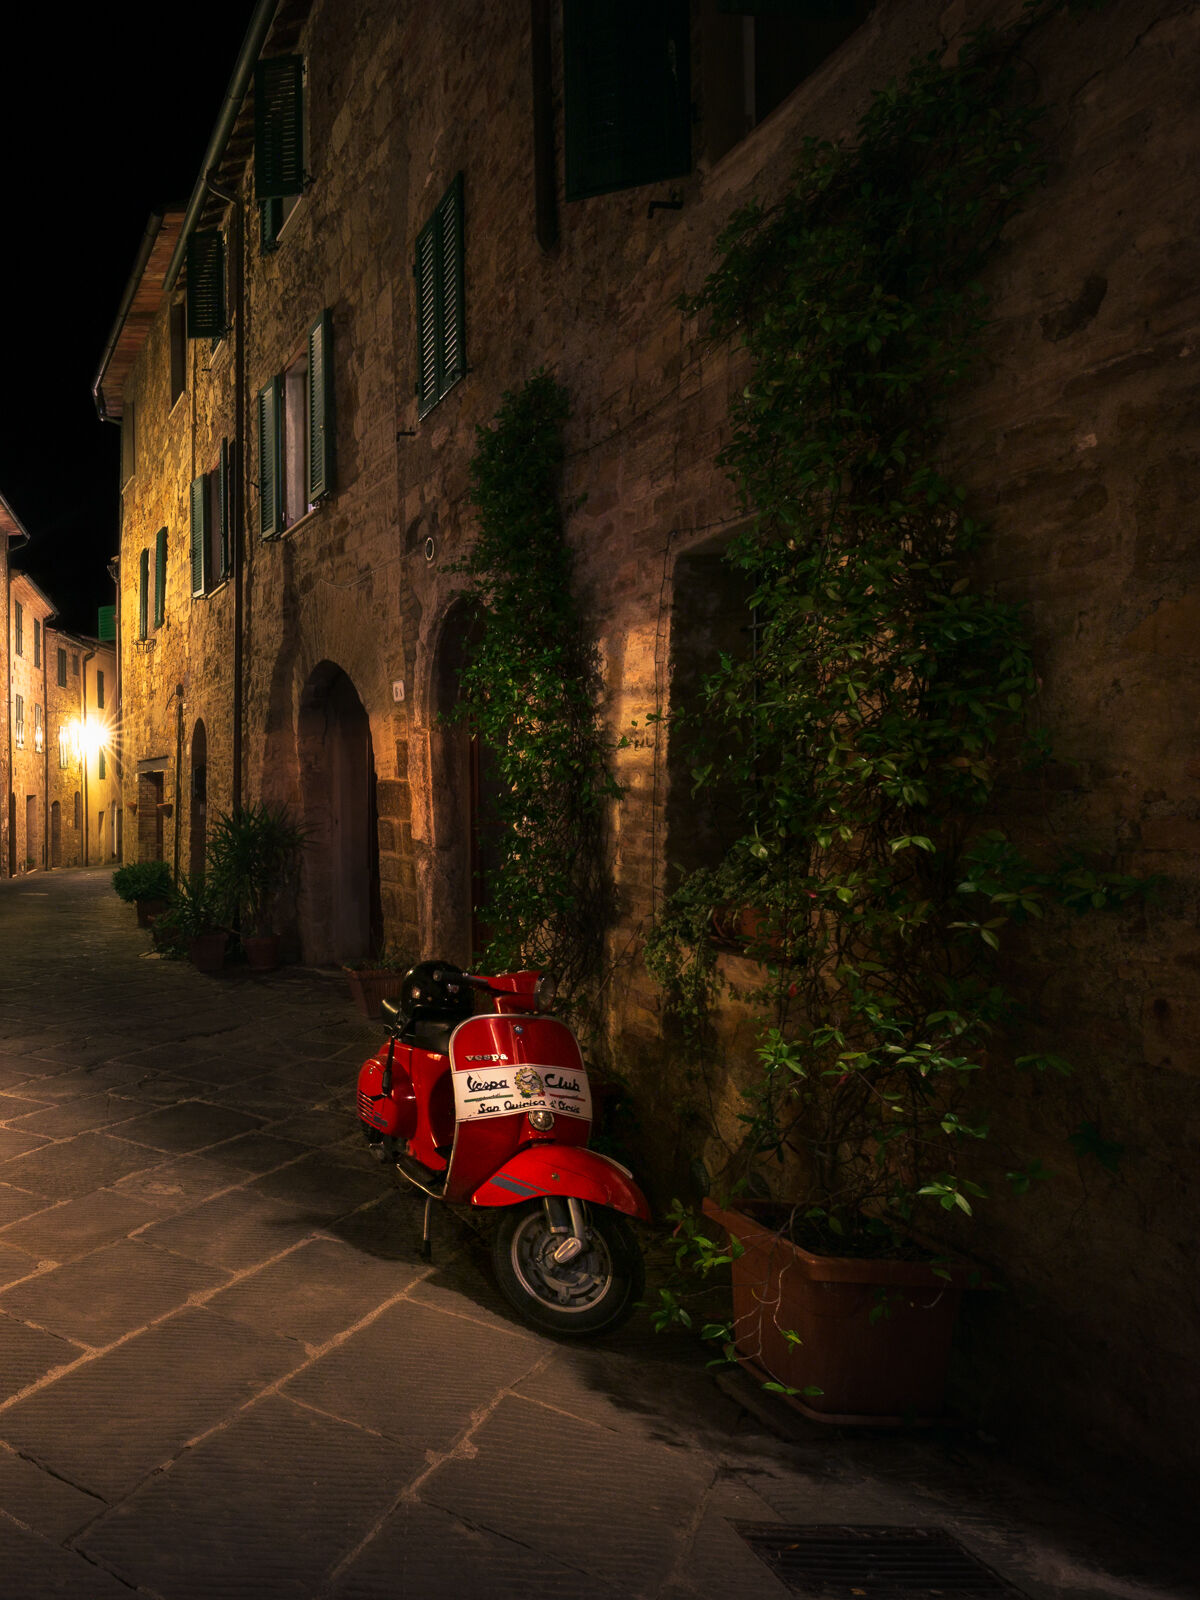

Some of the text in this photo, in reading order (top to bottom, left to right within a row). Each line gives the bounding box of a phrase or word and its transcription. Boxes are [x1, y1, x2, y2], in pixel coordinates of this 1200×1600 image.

[465, 1053, 508, 1061] vespa
[467, 1074, 580, 1093] Vespa Club
[478, 1103, 501, 1114] San
